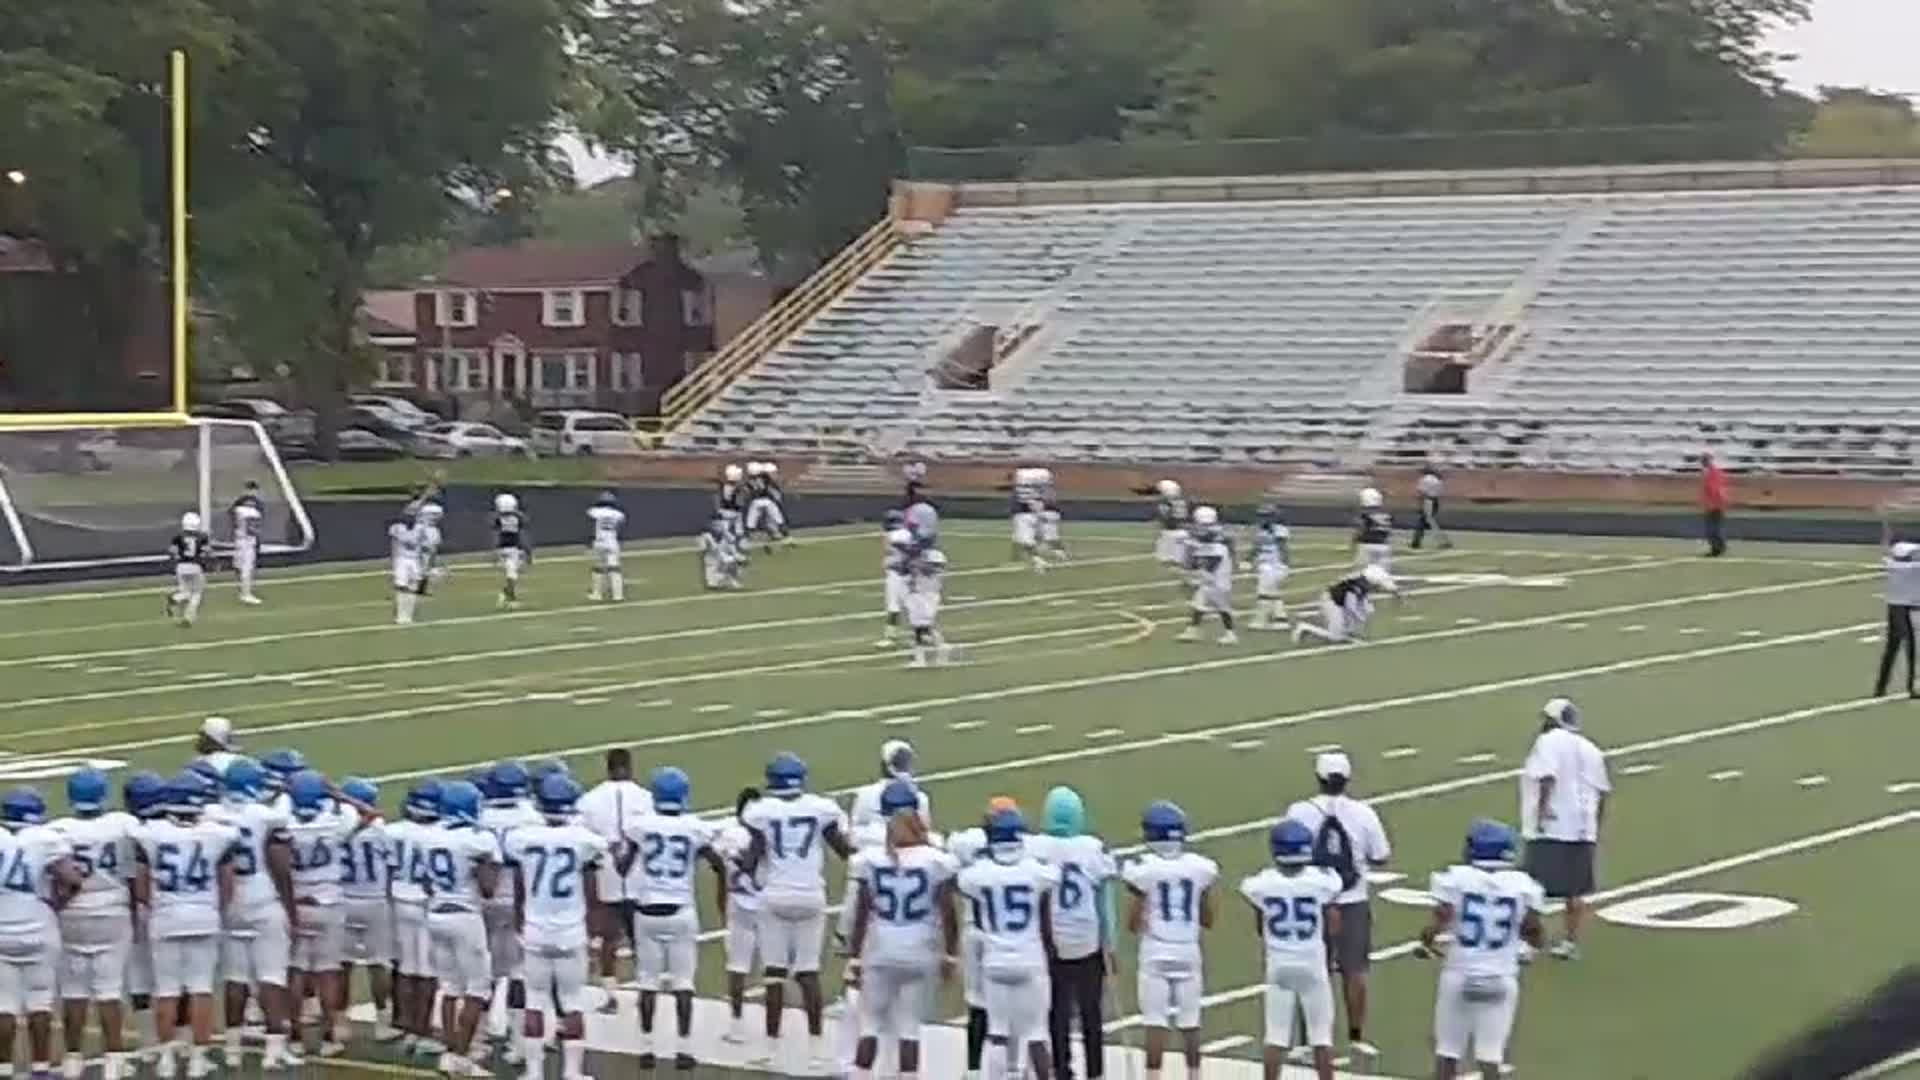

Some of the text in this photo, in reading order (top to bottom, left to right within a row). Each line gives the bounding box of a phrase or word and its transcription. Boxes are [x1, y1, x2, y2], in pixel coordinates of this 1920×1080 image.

[645, 832, 690, 878] 23
[769, 816, 820, 859] 17
[0, 848, 36, 892] 4
[156, 840, 210, 892] 54
[525, 846, 576, 898] 72
[1058, 863, 1083, 909] 6
[872, 866, 930, 921] 52
[981, 885, 1034, 932] 15
[1157, 879, 1194, 923] 11
[1263, 896, 1318, 940] 25
[1459, 892, 1517, 949] 53
